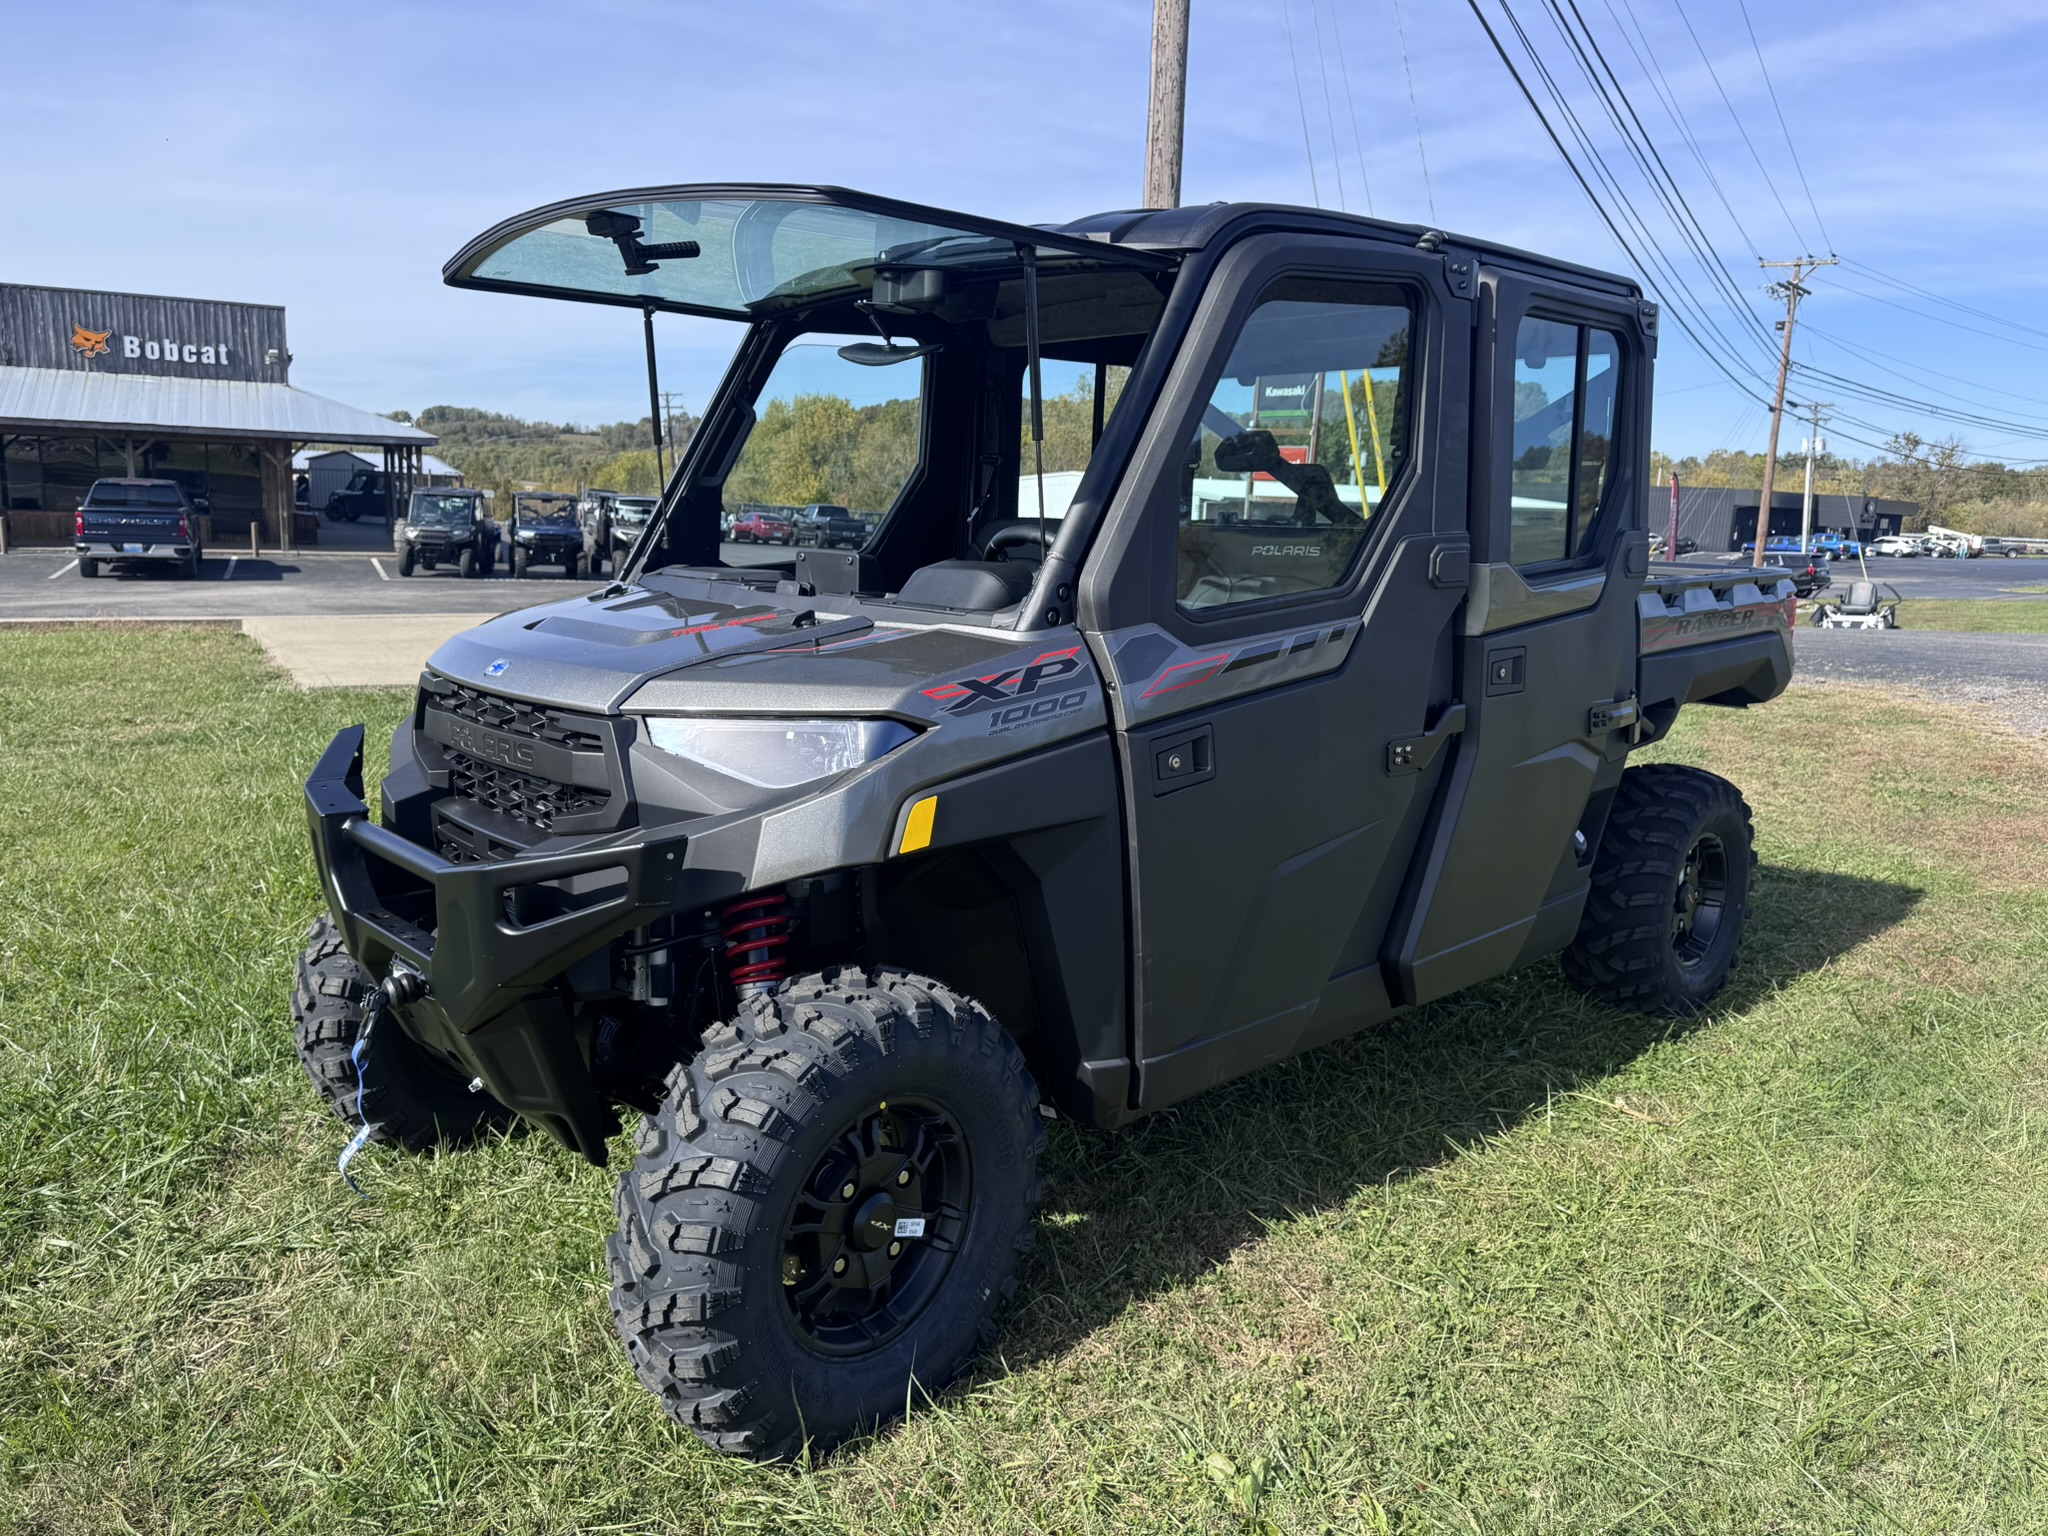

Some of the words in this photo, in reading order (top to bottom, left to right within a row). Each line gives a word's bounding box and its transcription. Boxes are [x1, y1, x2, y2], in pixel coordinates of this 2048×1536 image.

[122, 335, 229, 366] Bobcat
[1265, 385, 1306, 397] Kawasaki
[88, 517, 172, 525] CHEVROLET
[1251, 545, 1321, 557] POLARIS
[1674, 609, 1755, 636] RANGER
[937, 655, 1082, 712] XP
[988, 725, 1012, 736] DUAL
[1013, 712, 1062, 732] OVERHEAD
[1063, 706, 1083, 719] CAM
[989, 690, 1088, 728] 1000
[448, 720, 535, 770] POLARIS
